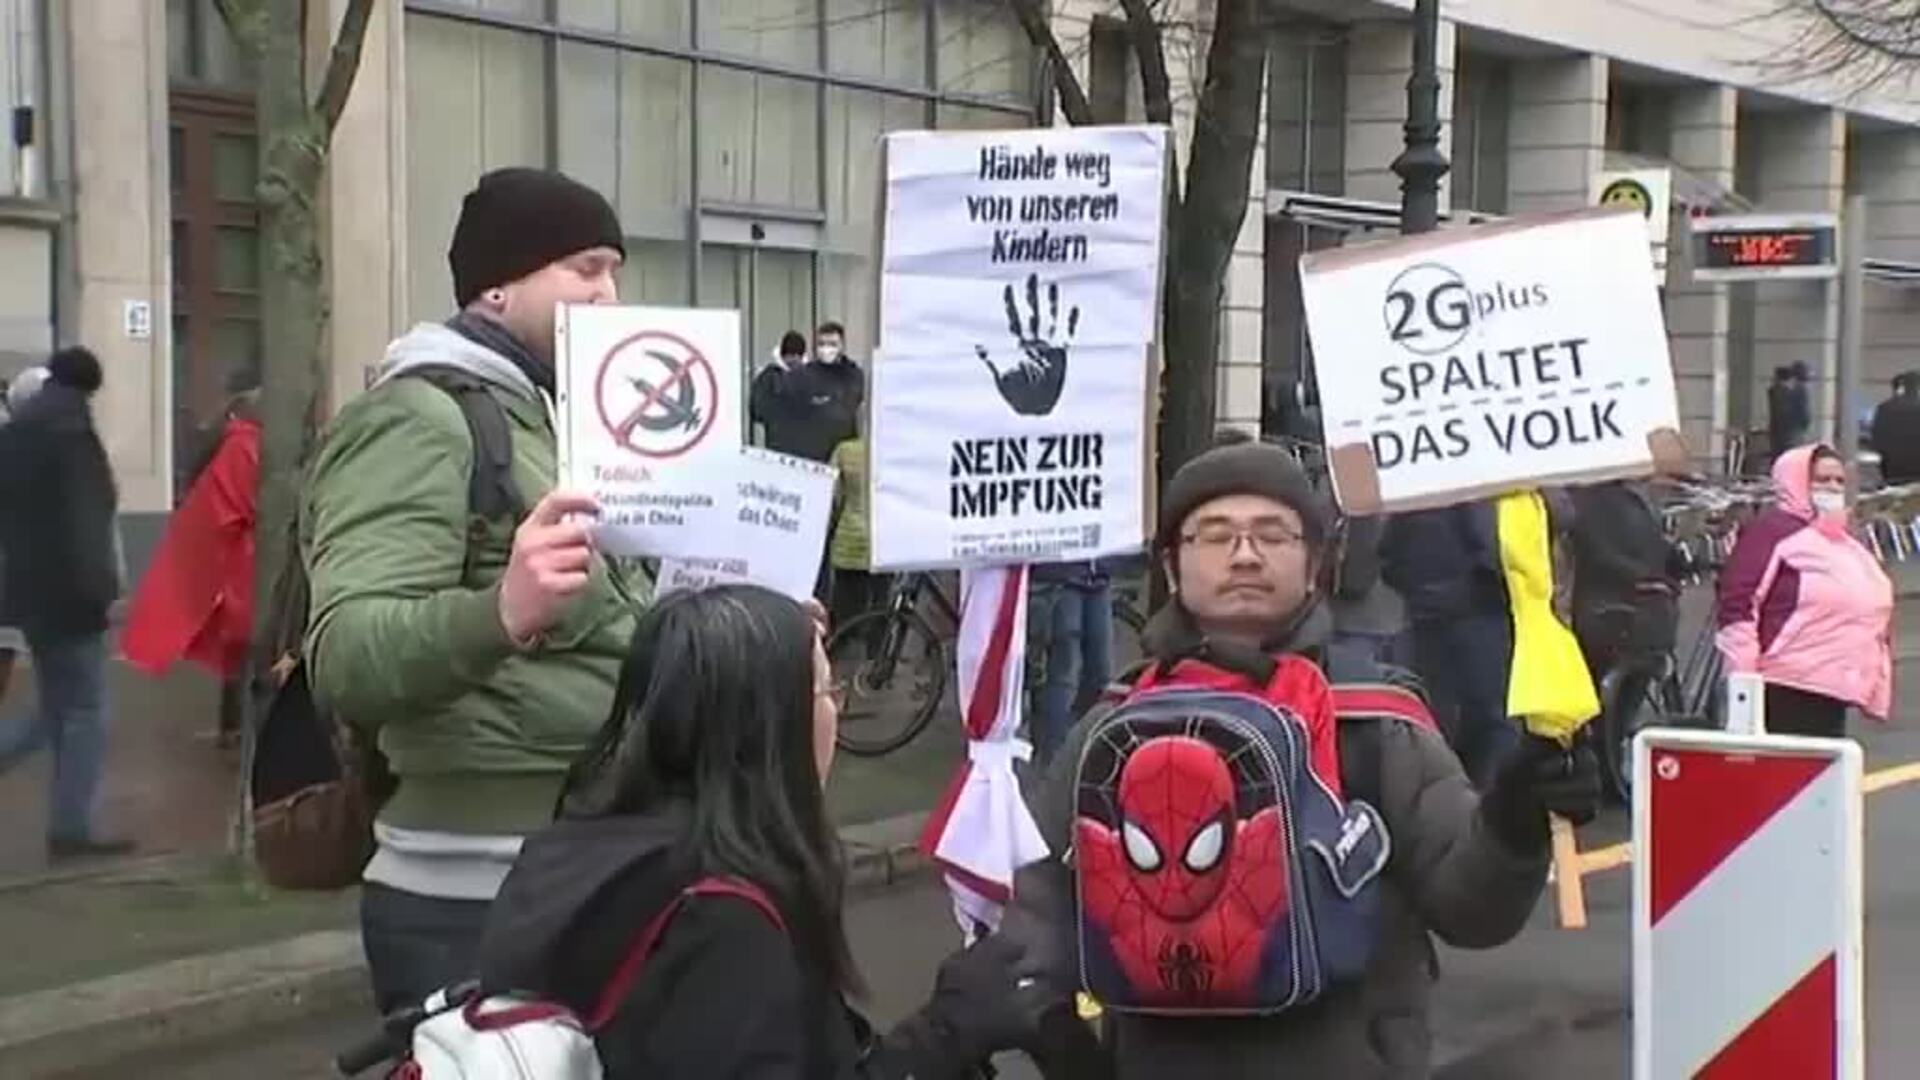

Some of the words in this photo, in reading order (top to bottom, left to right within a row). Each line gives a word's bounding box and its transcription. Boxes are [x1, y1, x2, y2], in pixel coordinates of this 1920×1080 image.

[980, 145, 1057, 181] Hände
[1065, 152, 1111, 187] weg
[967, 195, 1012, 222] von
[1020, 192, 1119, 222] unseren
[990, 228, 1088, 263] Kindern
[1476, 280, 1550, 318] plus
[1379, 337, 1589, 405] SPALTET
[950, 436, 1028, 477] NEIN
[1036, 433, 1103, 470] ZUR
[1372, 418, 1471, 470] DAS
[1484, 399, 1623, 453] VOLK
[950, 474, 1103, 518] IMPFUNG
[649, 509, 684, 526] China
